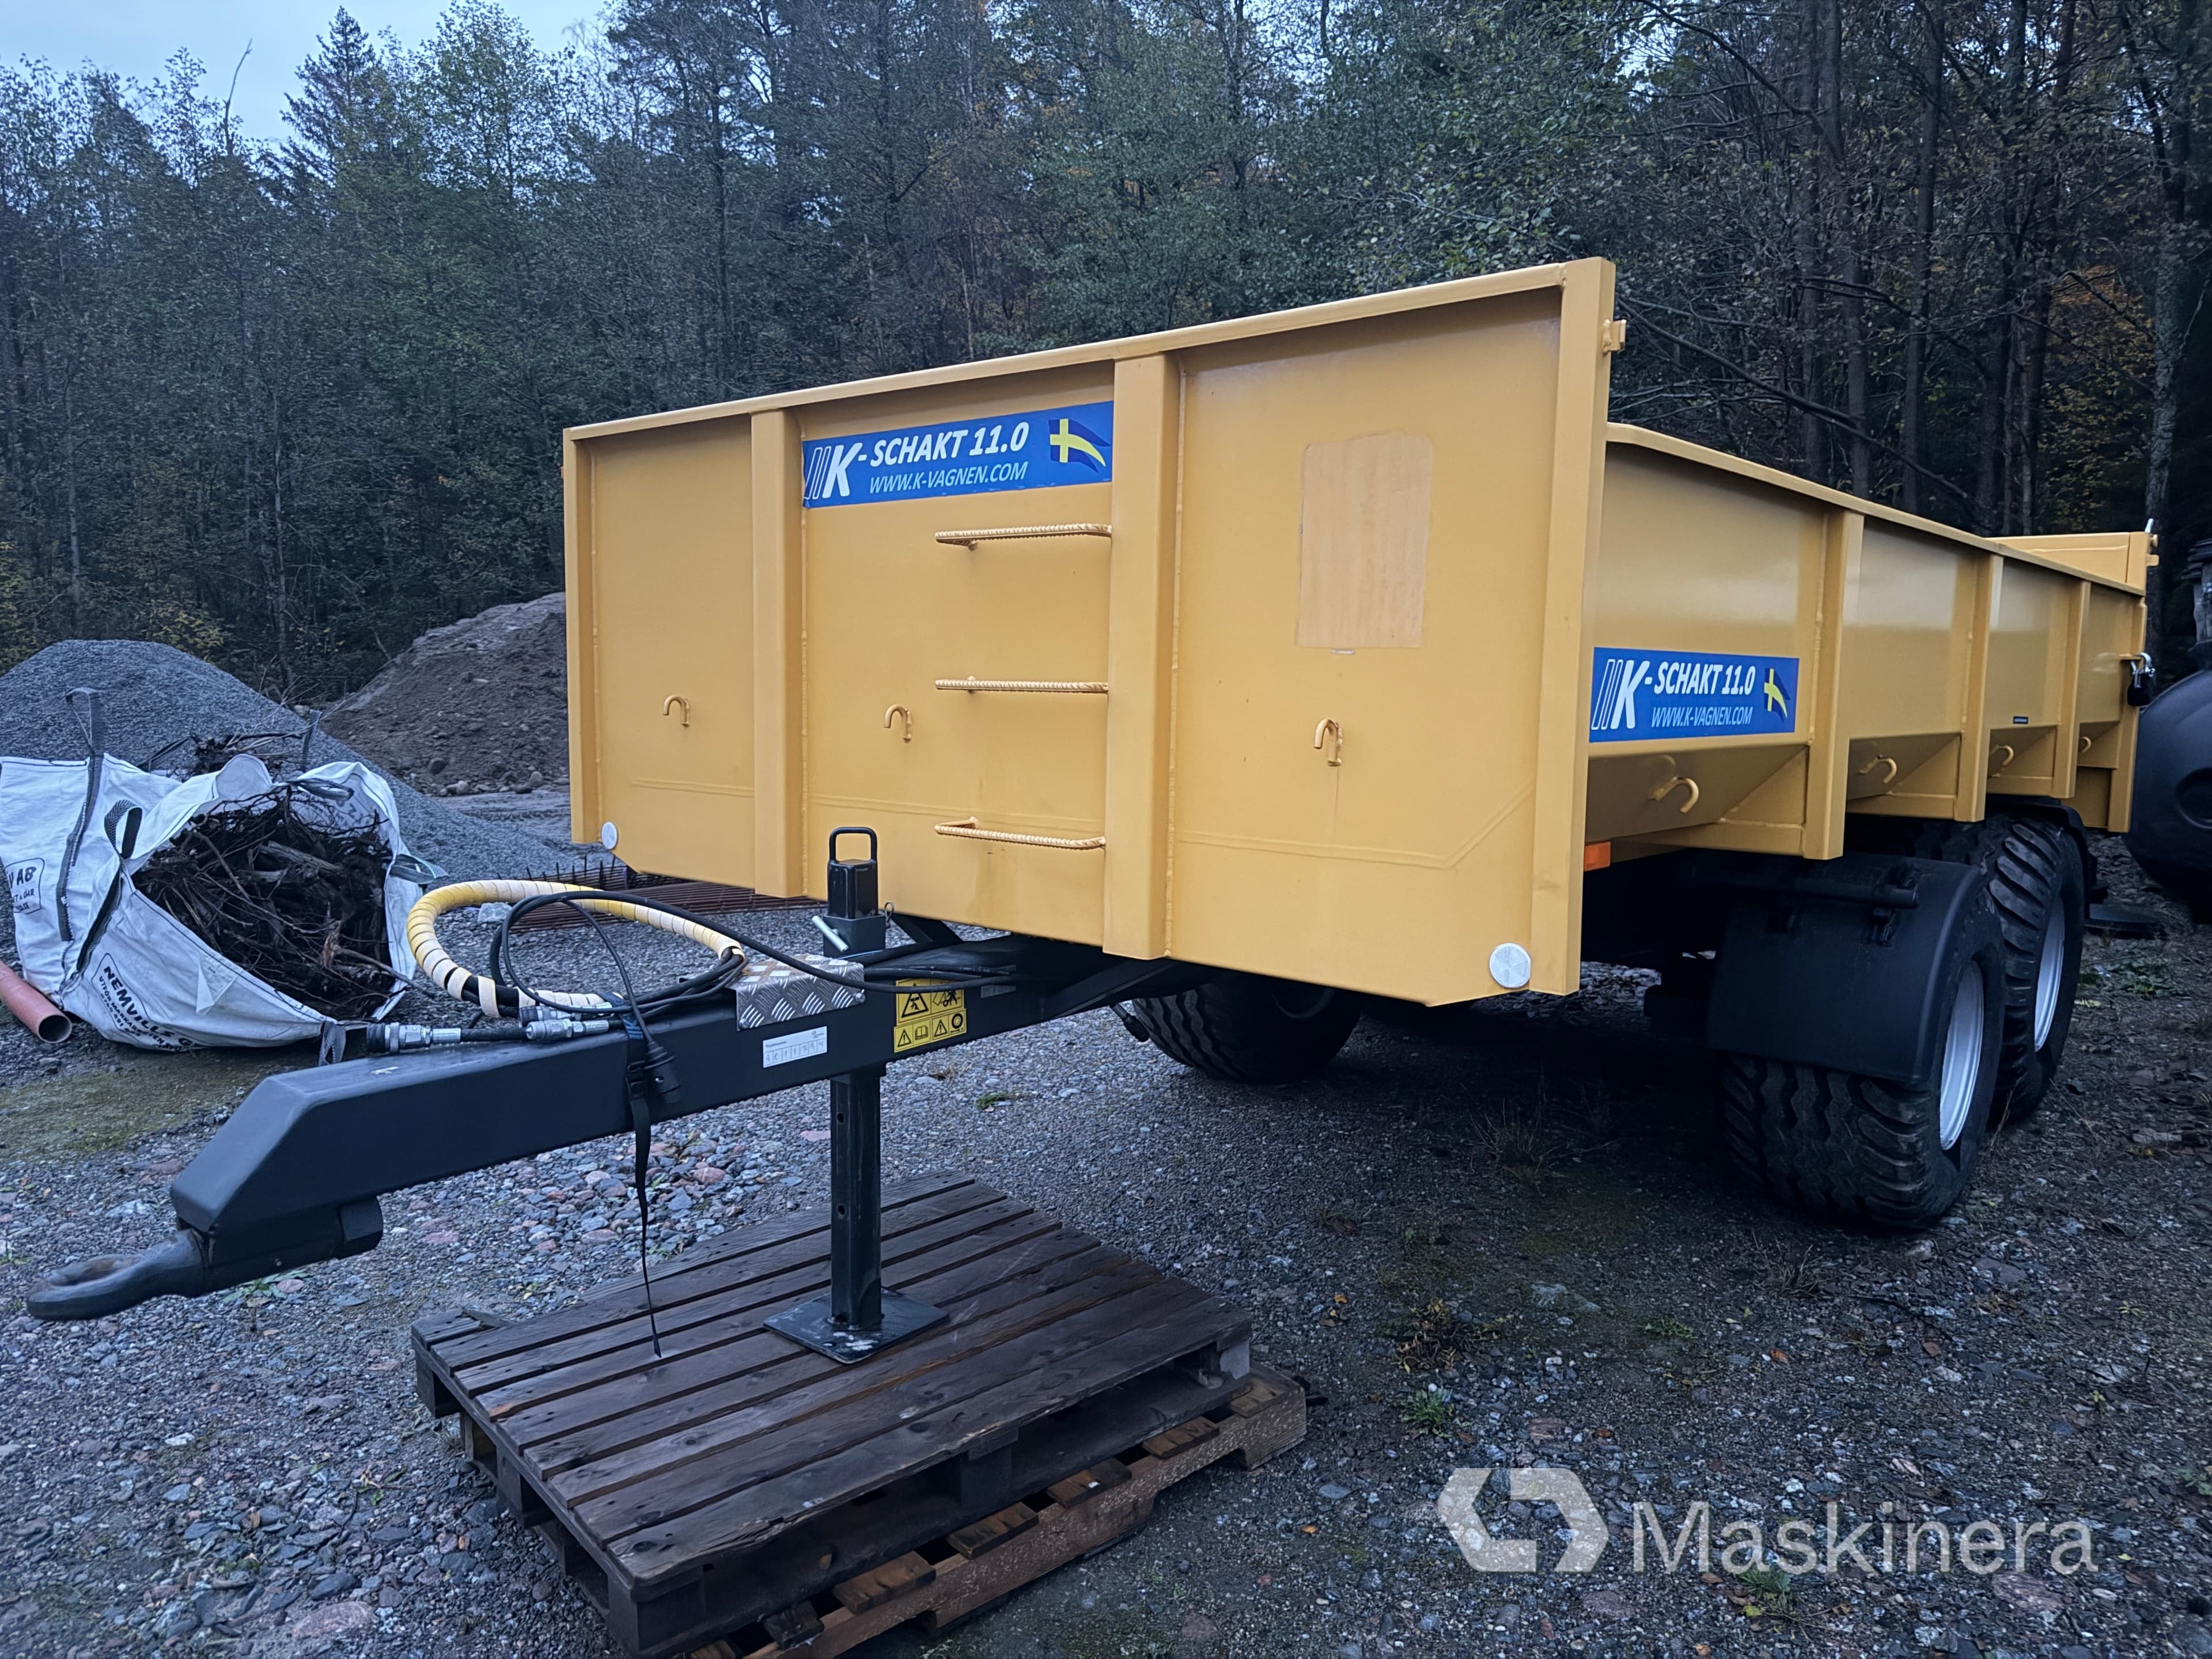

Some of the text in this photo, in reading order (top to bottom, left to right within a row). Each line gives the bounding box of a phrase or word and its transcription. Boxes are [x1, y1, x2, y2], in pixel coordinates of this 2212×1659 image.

[969, 422, 1029, 456] 11.0
[869, 461, 1028, 494] WWW.K-VAGNEN.COM
[1721, 665, 1756, 696] 11.0
[1651, 706, 1753, 728] WWW.K-VAGNEN.COM
[17, 866, 37, 885] AB
